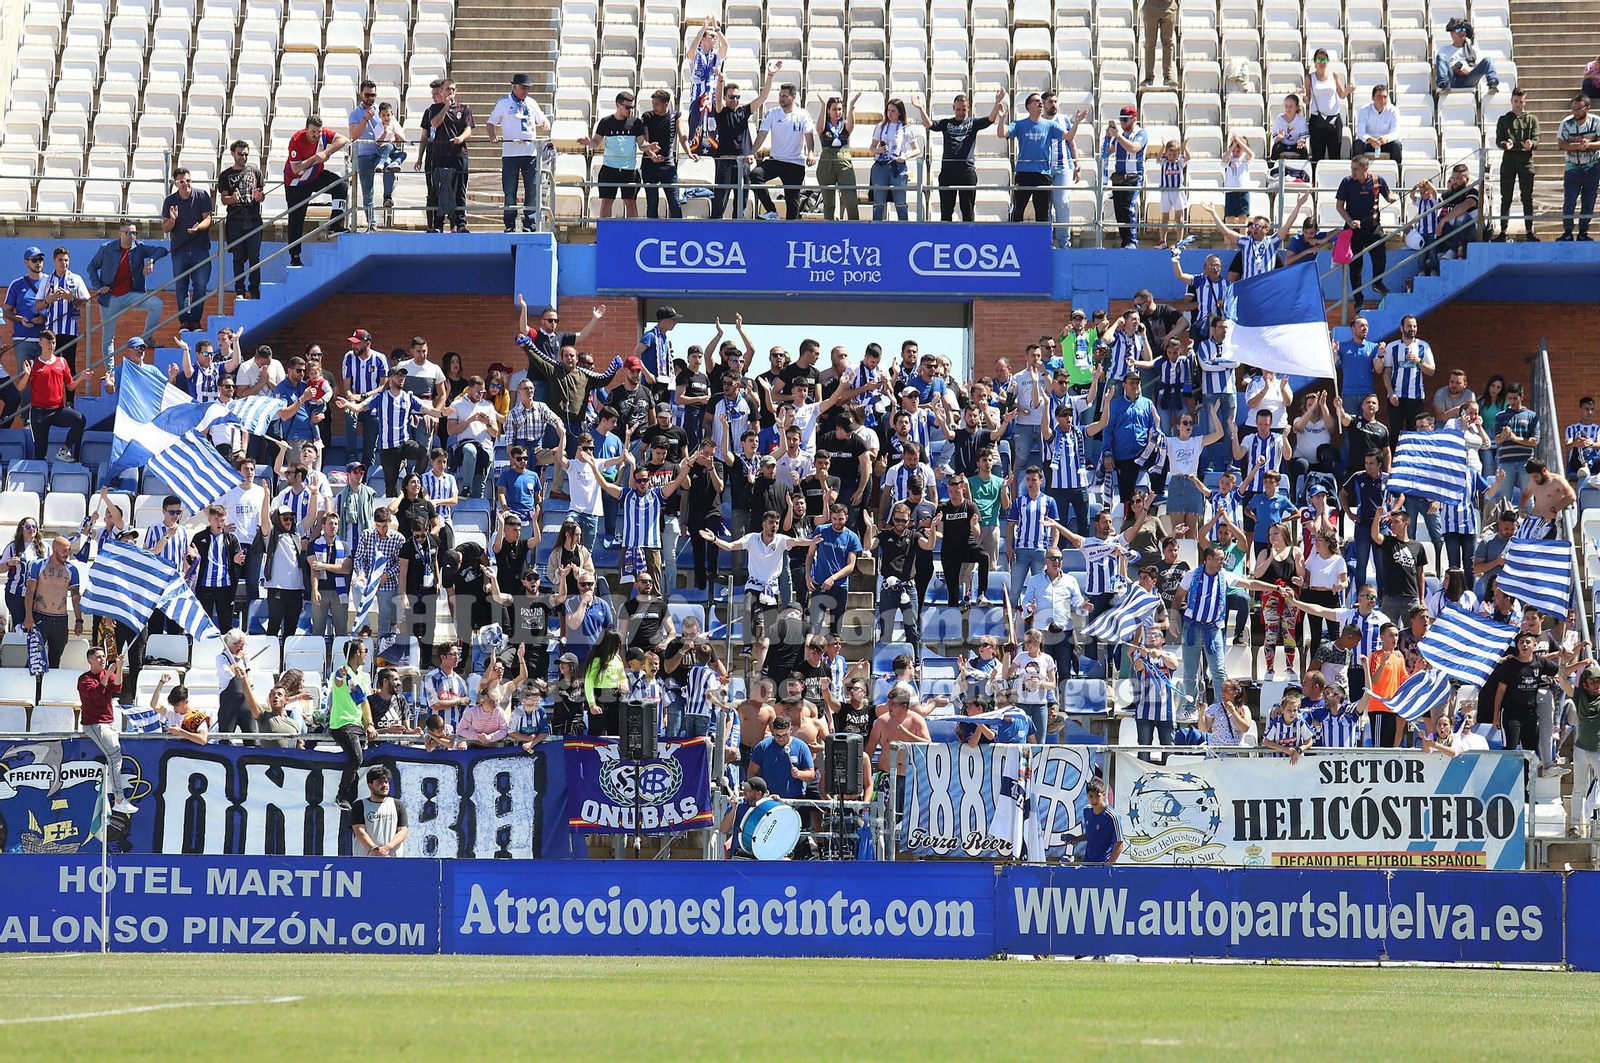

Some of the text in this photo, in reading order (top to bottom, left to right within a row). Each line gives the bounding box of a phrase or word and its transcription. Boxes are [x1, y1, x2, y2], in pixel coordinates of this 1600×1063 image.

[635, 238, 747, 274] CEOSA
[786, 238, 882, 270] Huelva
[909, 241, 1021, 276] CEOSA
[809, 268, 882, 286] me pone
[9, 769, 53, 782] FRENTE
[1319, 759, 1425, 784] SECTOR
[580, 796, 699, 830] ONUBAS
[1232, 788, 1516, 842] HELICÓSTERO
[908, 828, 958, 850] Forza
[1133, 832, 1201, 858] Sector Helicóstero
[1201, 851, 1216, 862] Sur
[1280, 851, 1481, 867] DECANO DEL FÚTBOL ESPAÑOL
[59, 864, 362, 899] HOTEL MARTÍN
[460, 884, 975, 937] Atraccioneslacinta.com
[1015, 887, 1543, 945] WWW.autopartshuelva.es
[0, 913, 425, 947] ALONSO PINZÓN.COM
